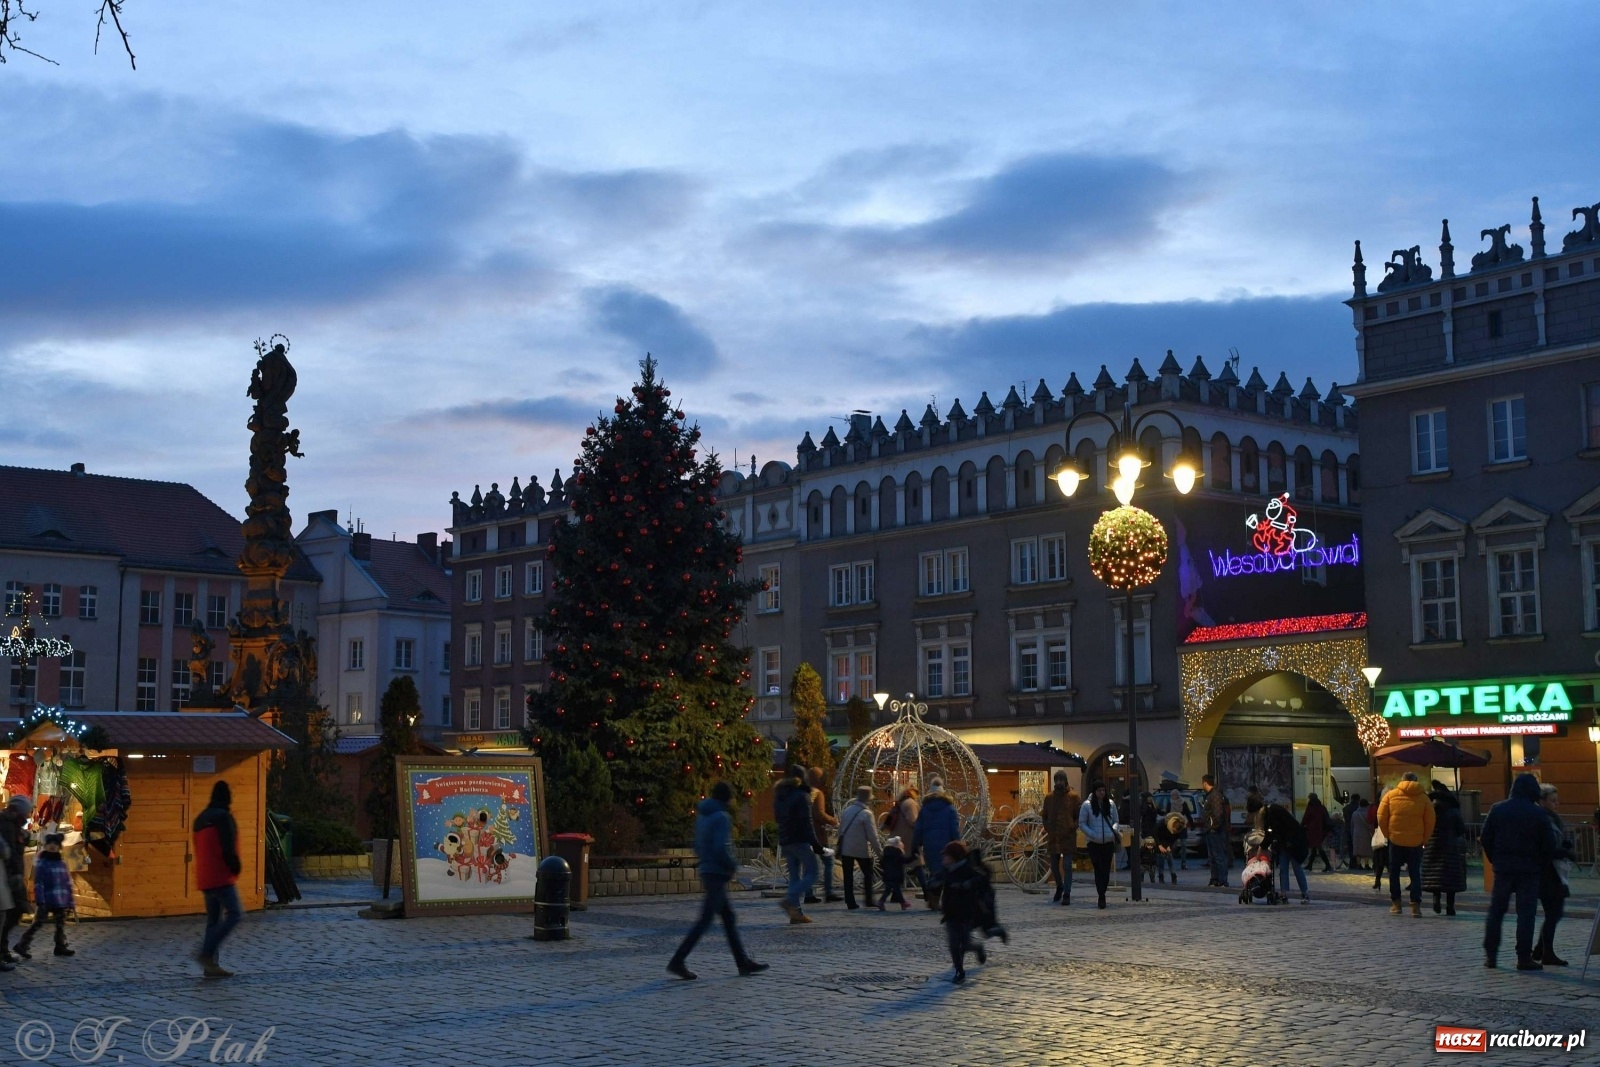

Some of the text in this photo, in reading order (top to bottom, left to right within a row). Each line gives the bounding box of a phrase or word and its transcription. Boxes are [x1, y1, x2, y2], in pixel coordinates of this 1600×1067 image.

[1382, 682, 1573, 717] APTEKA
[1502, 712, 1569, 722] POD RÓŻAMI
[1400, 728, 1426, 737] RYNEK
[1442, 726, 1479, 736] CENTRUM
[1480, 724, 1554, 734] FARMACEUTYCZNE
